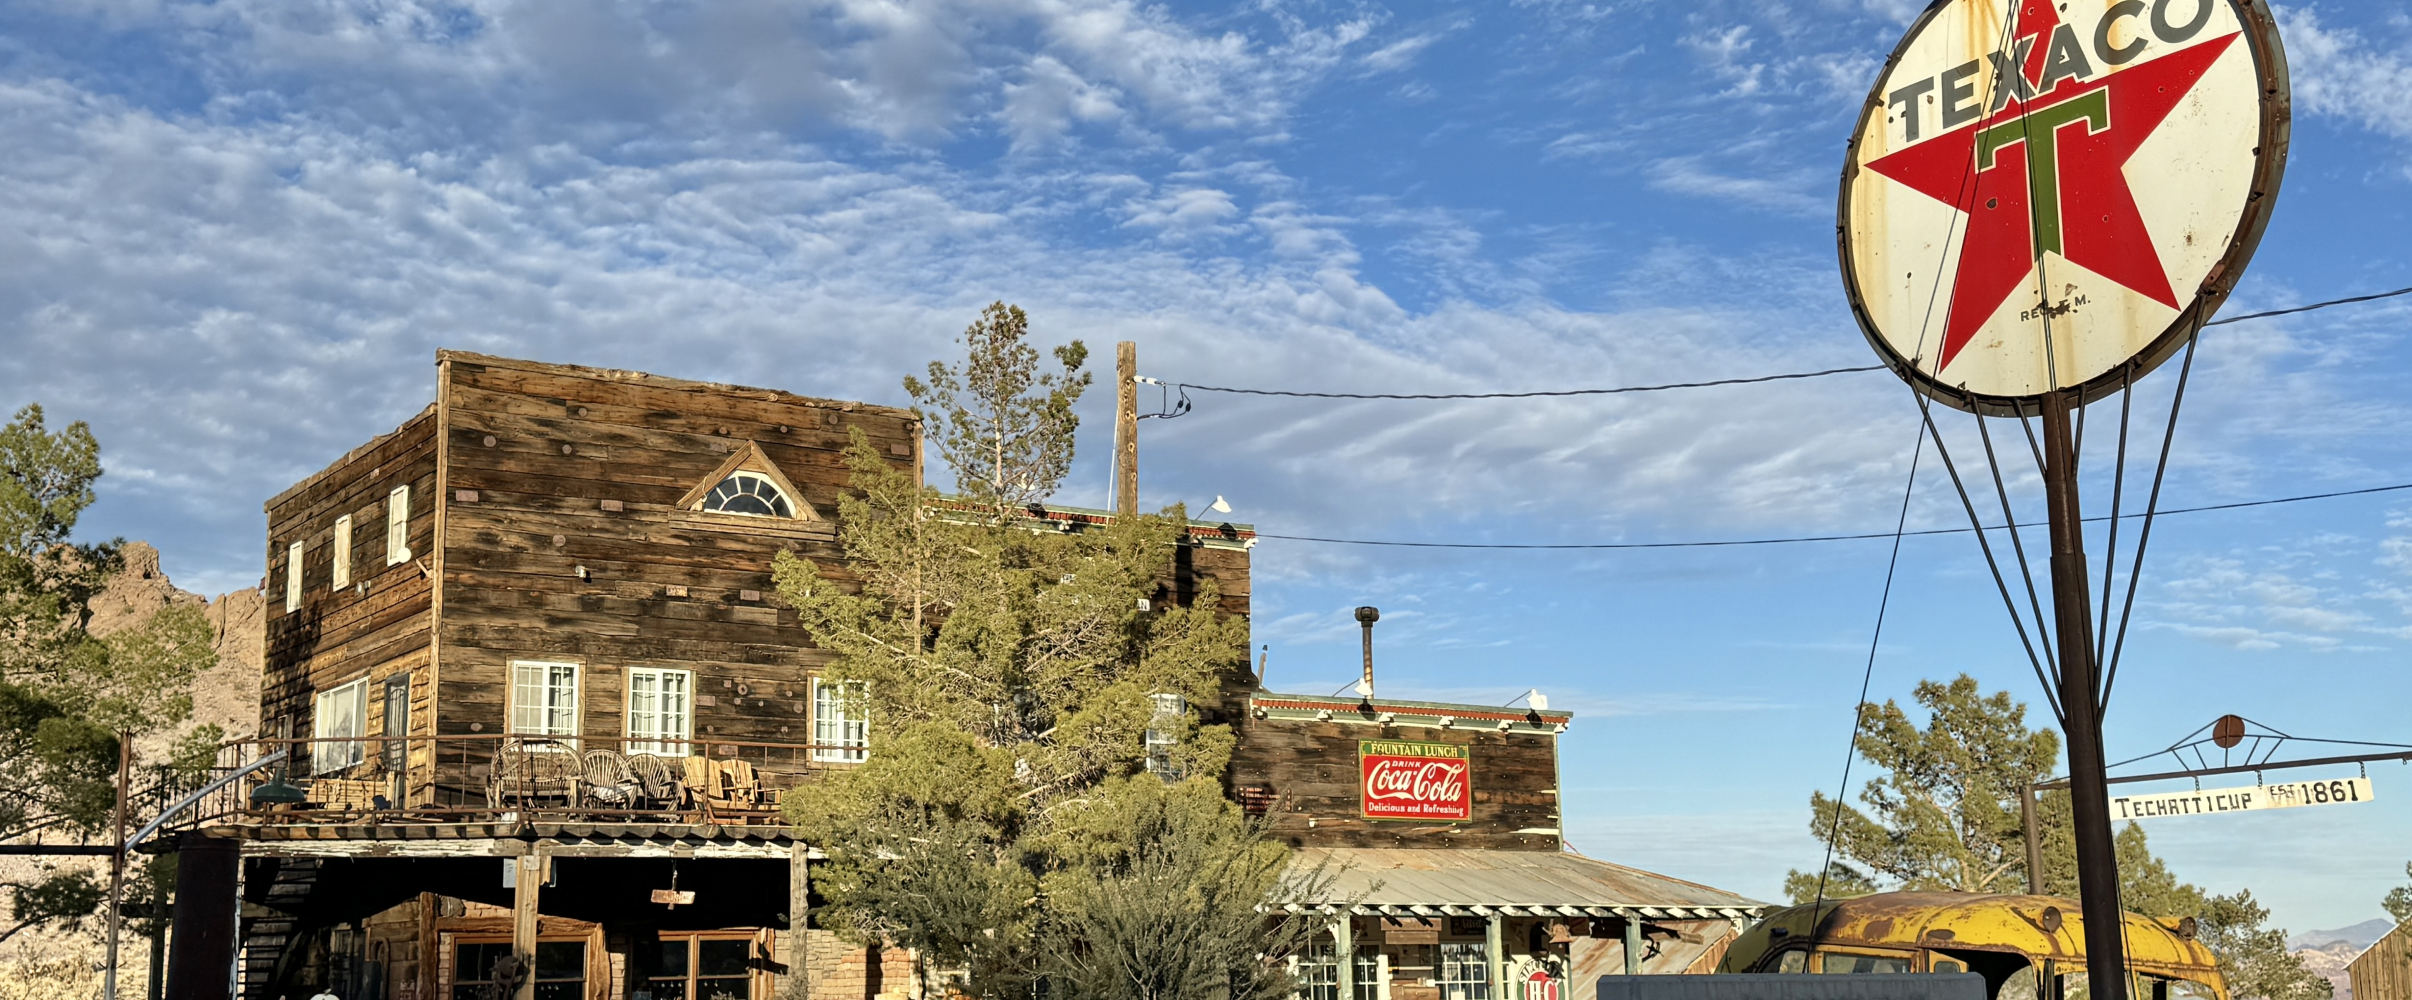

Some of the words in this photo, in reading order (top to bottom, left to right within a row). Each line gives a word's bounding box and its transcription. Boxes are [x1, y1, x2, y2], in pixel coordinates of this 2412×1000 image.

[1888, 0, 2214, 142] TEXACO
[1976, 87, 2110, 262] T
[1371, 743, 1421, 756] FOUNTAIN
[1424, 746, 1458, 757] LUNCH
[1367, 760, 1466, 801] Coca-Cola
[2115, 793, 2251, 818] TECHATTICUP
[2301, 780, 2359, 804] 1861
[1368, 802, 1405, 812] Delicious
[1407, 804, 1420, 813] and
[1423, 804, 1464, 817] Refreshing
